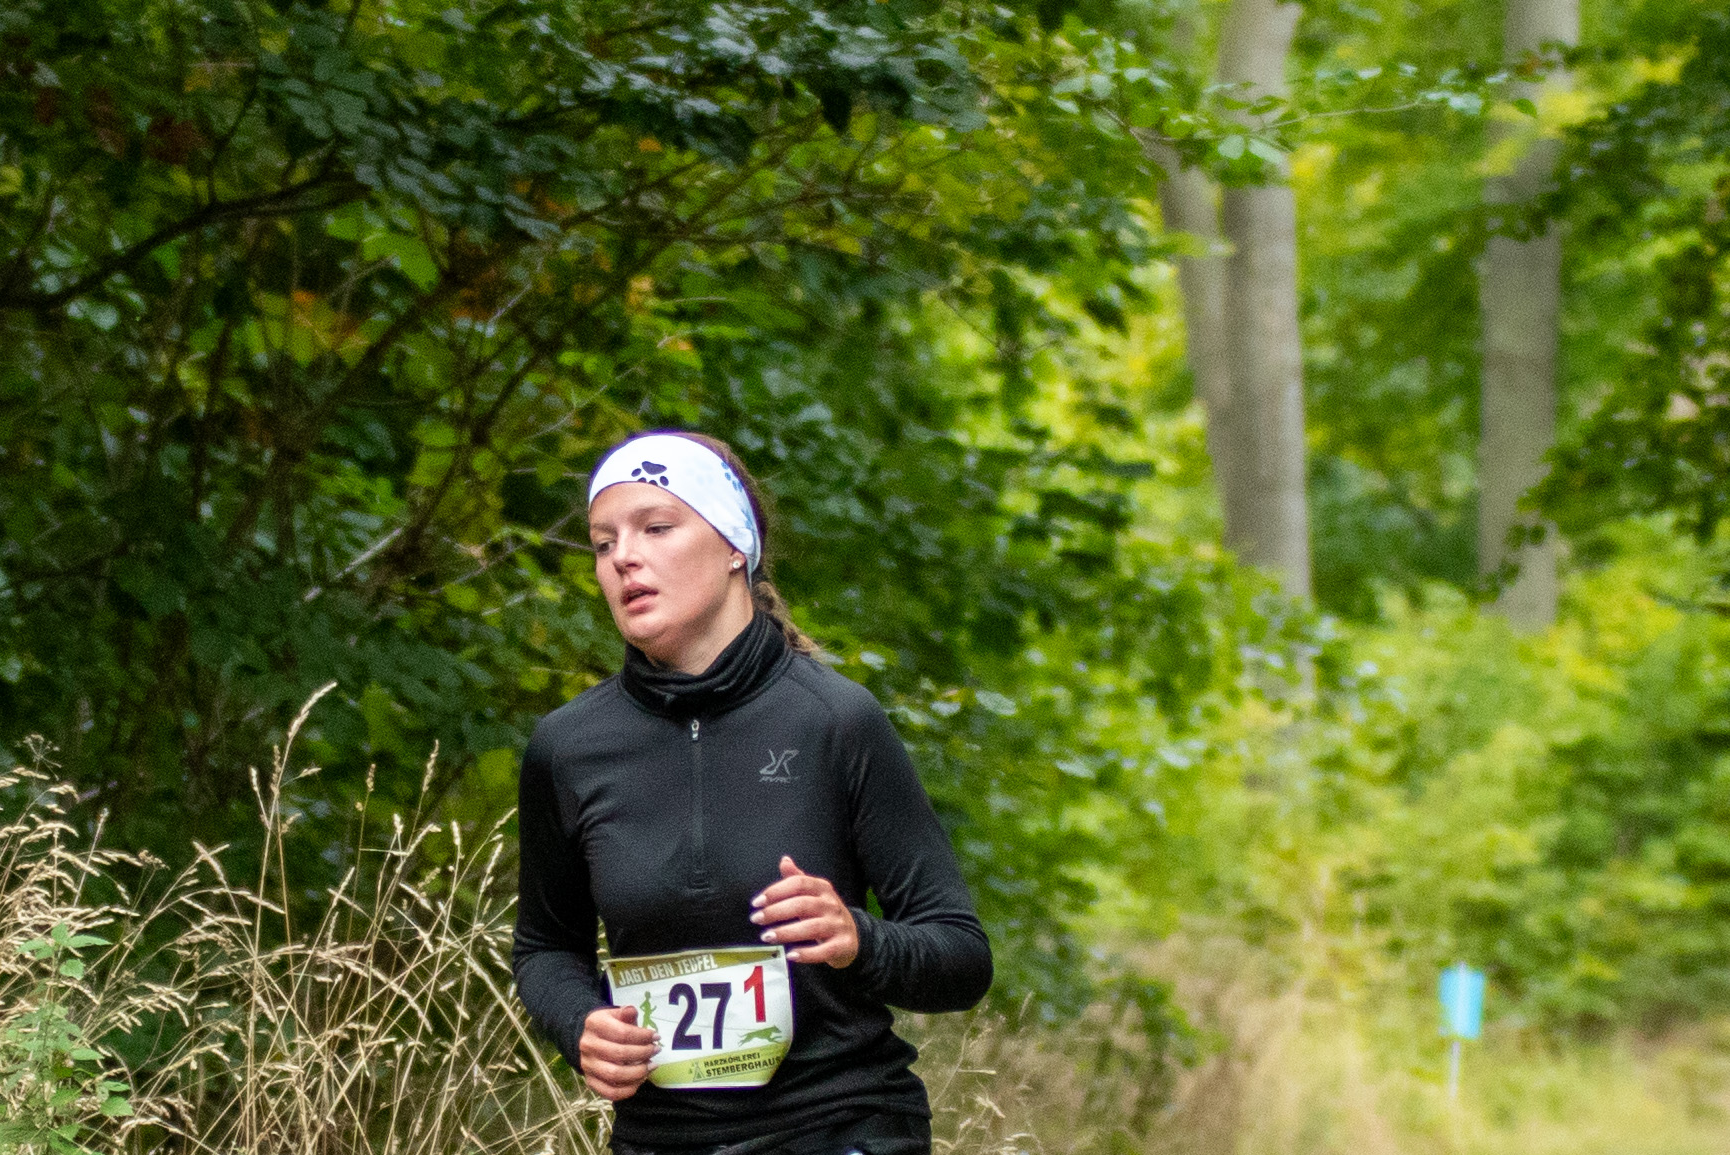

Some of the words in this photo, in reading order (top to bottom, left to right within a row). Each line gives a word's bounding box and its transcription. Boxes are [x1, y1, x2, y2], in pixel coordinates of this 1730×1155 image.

[618, 967, 647, 986] JAGT
[648, 962, 675, 980] DEN
[675, 953, 718, 975] TEUFEL
[668, 982, 732, 1050] 27
[744, 965, 766, 1022] 1
[705, 1056, 781, 1077] STEMBERGHAUS
